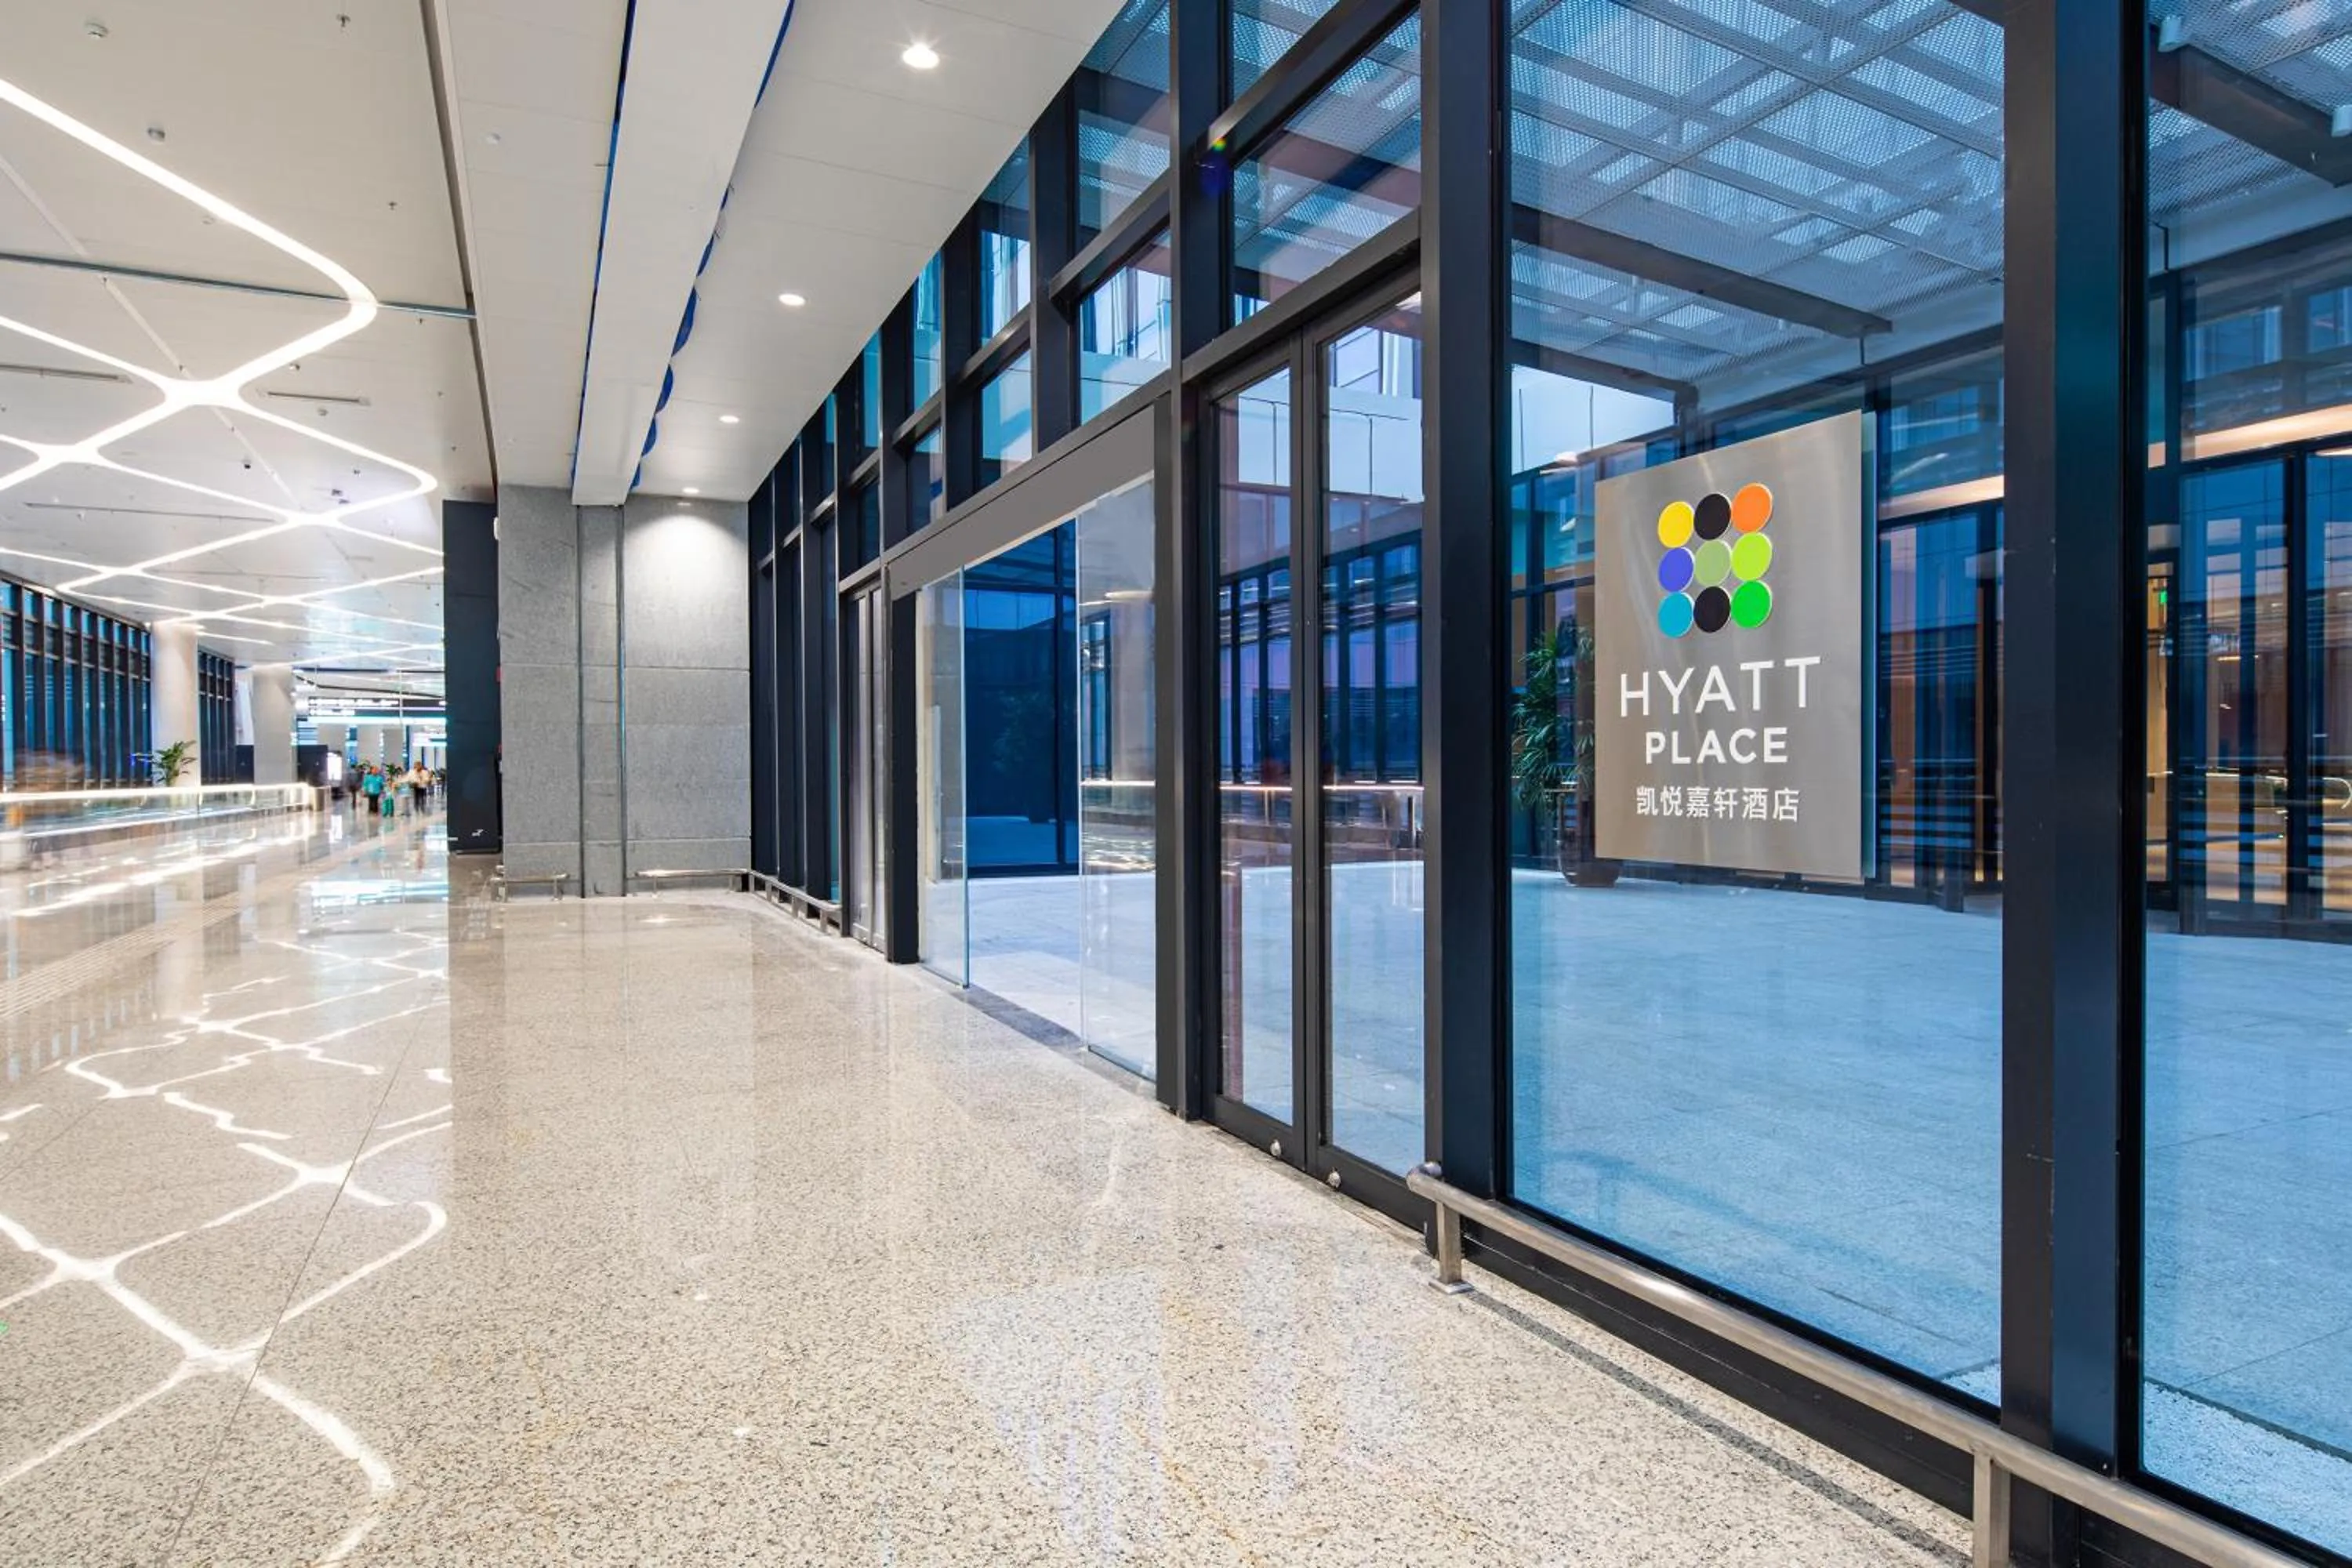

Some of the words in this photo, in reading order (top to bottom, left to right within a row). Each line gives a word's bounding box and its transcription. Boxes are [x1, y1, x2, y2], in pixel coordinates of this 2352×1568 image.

[1621, 656, 1821, 717] HYATT
[1646, 727, 1788, 764] PLACE
[1635, 785, 1801, 822] 凯悦嘉轩酒店
